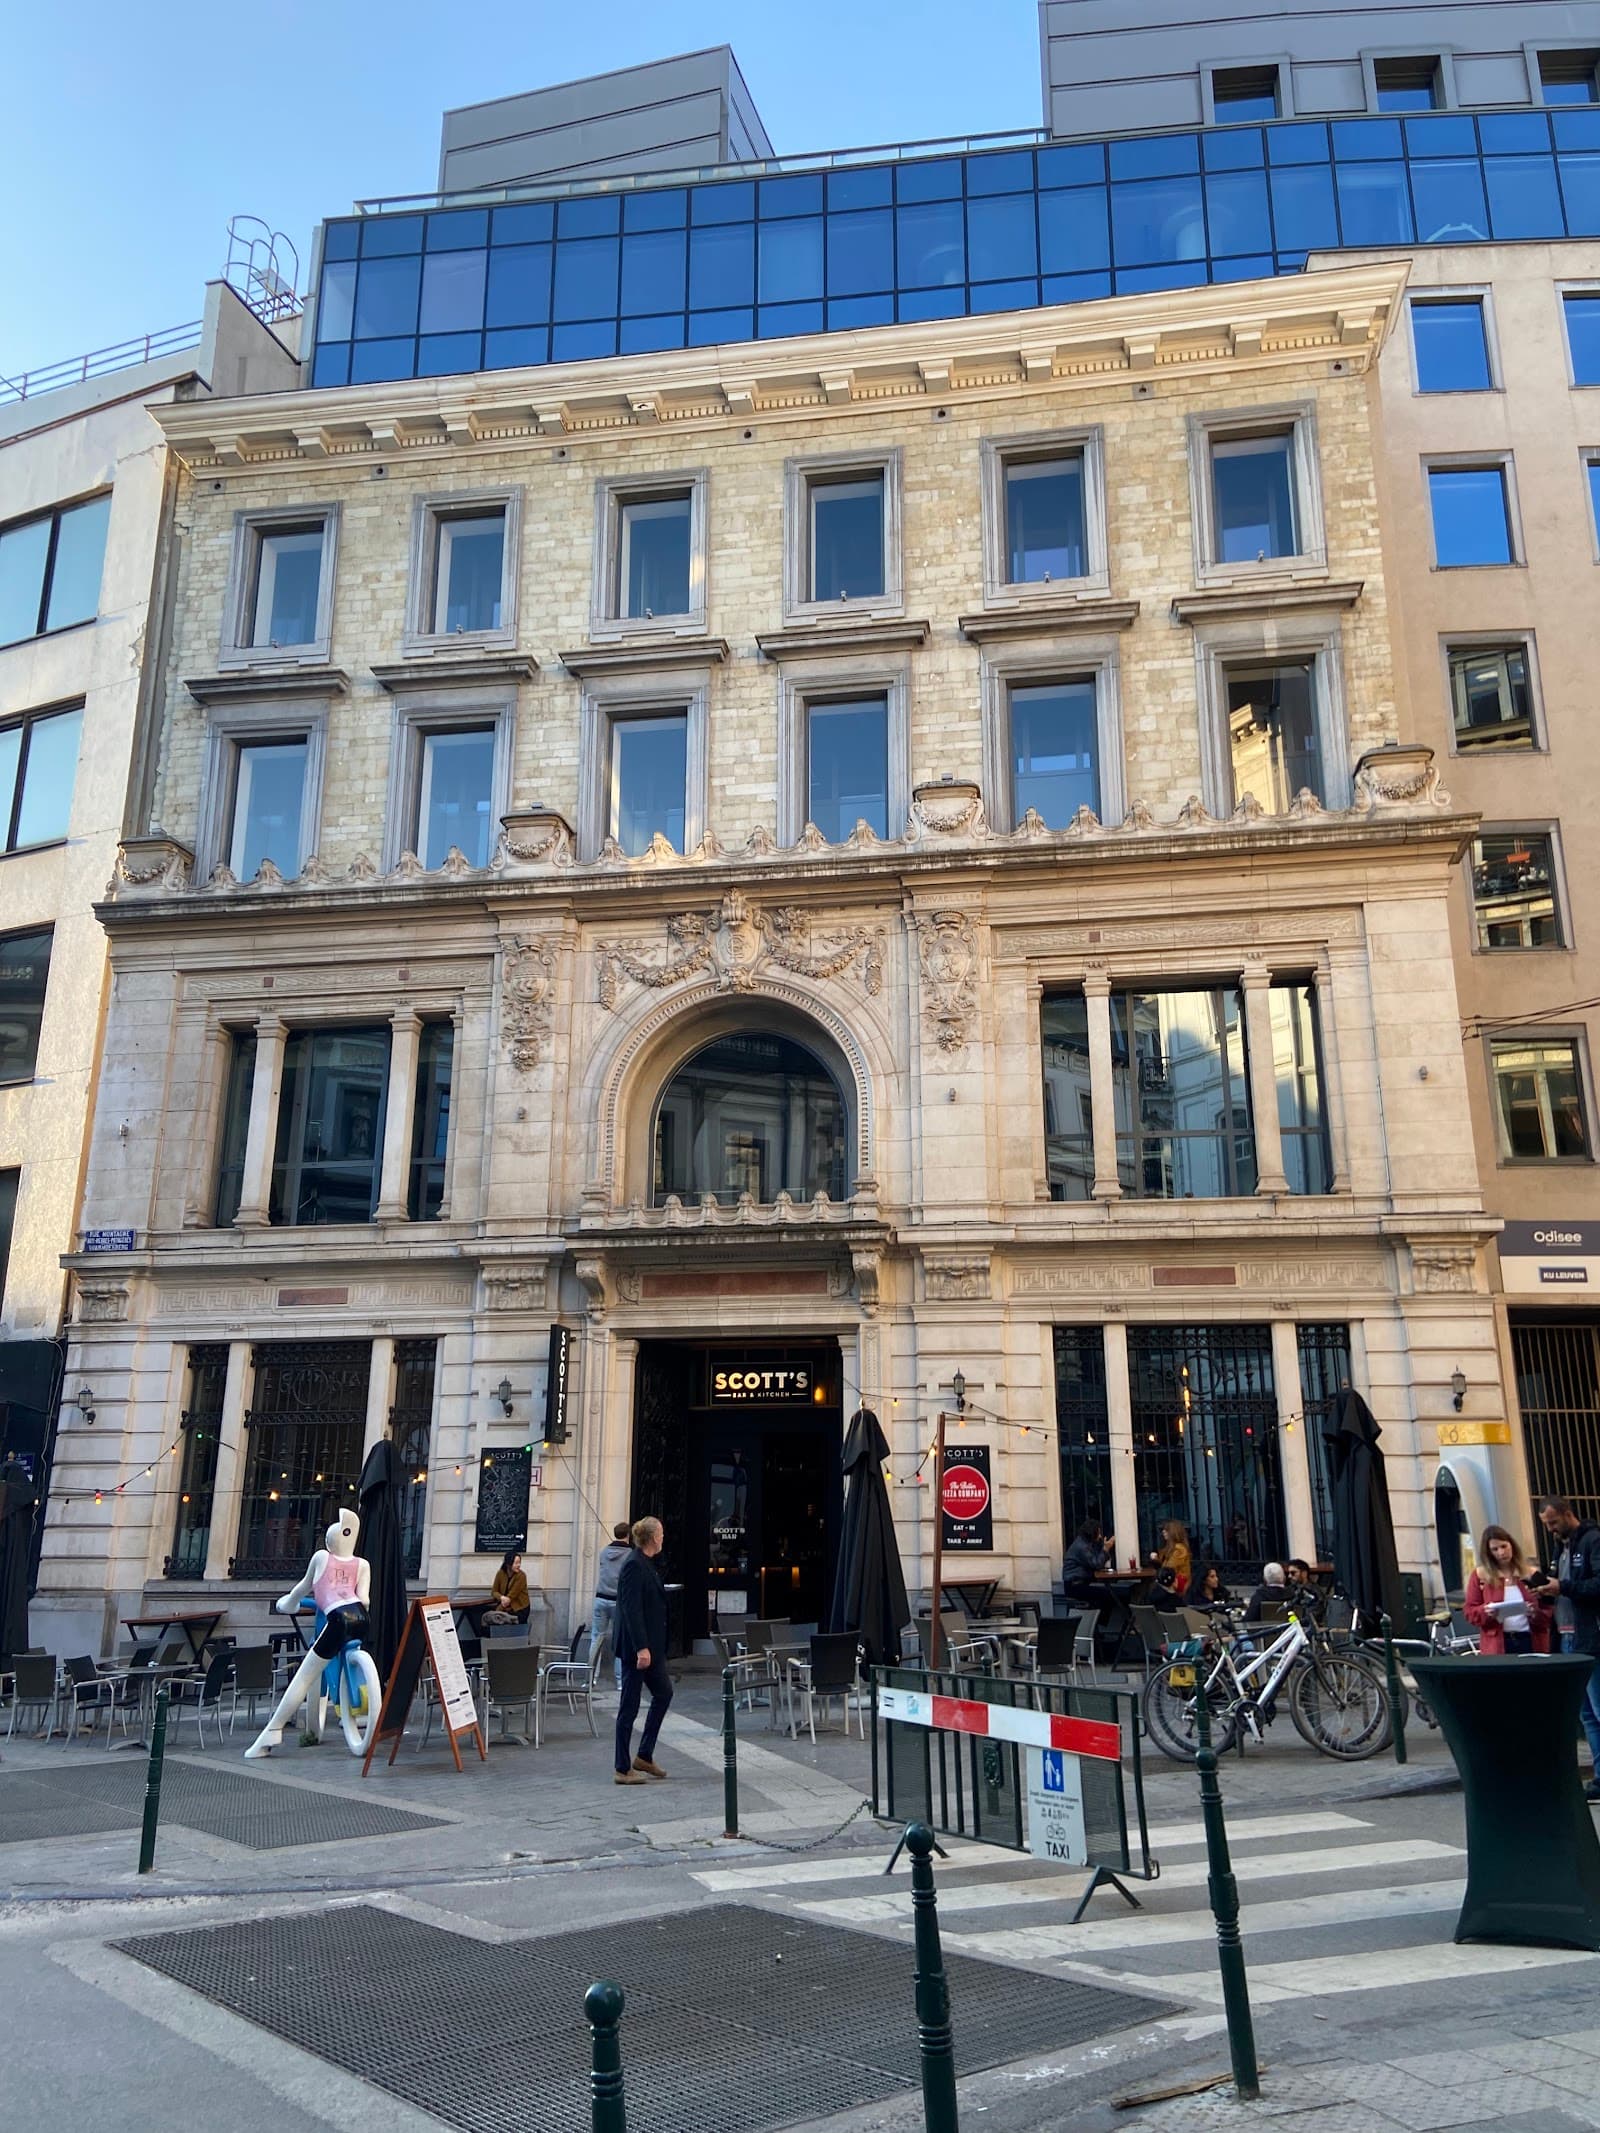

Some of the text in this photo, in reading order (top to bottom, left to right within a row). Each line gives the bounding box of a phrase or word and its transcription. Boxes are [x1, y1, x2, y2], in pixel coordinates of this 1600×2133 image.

[1534, 1231, 1582, 1242] Odisee
[715, 1372, 808, 1389] SCOTT'S
[958, 1489, 986, 1498] COMPANY
[1045, 1841, 1070, 1860] TAXI
